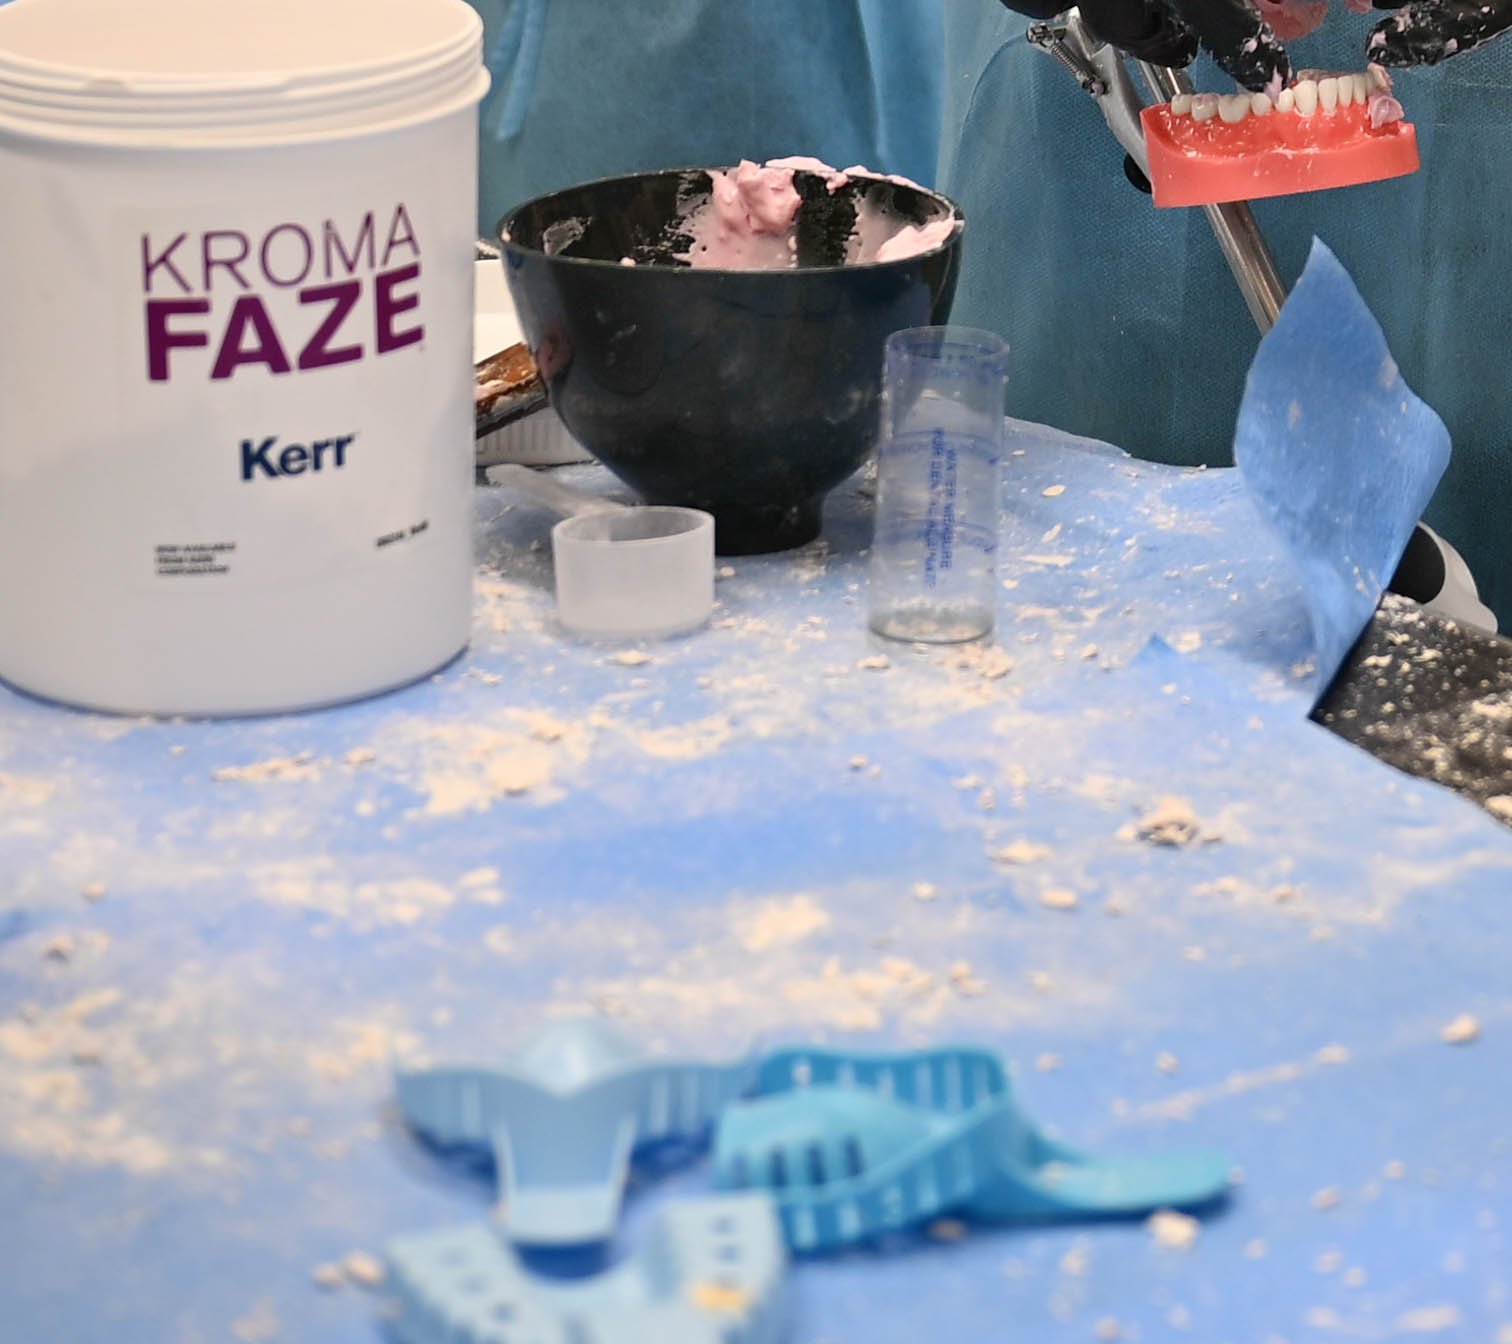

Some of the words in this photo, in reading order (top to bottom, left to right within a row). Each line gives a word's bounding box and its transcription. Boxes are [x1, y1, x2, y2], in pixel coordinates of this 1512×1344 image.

[141, 202, 421, 294] KROMA
[146, 261, 425, 382] FAZE
[240, 433, 357, 482] Kerr
[945, 447, 958, 496] WATER
[941, 501, 955, 570] MEASURE
